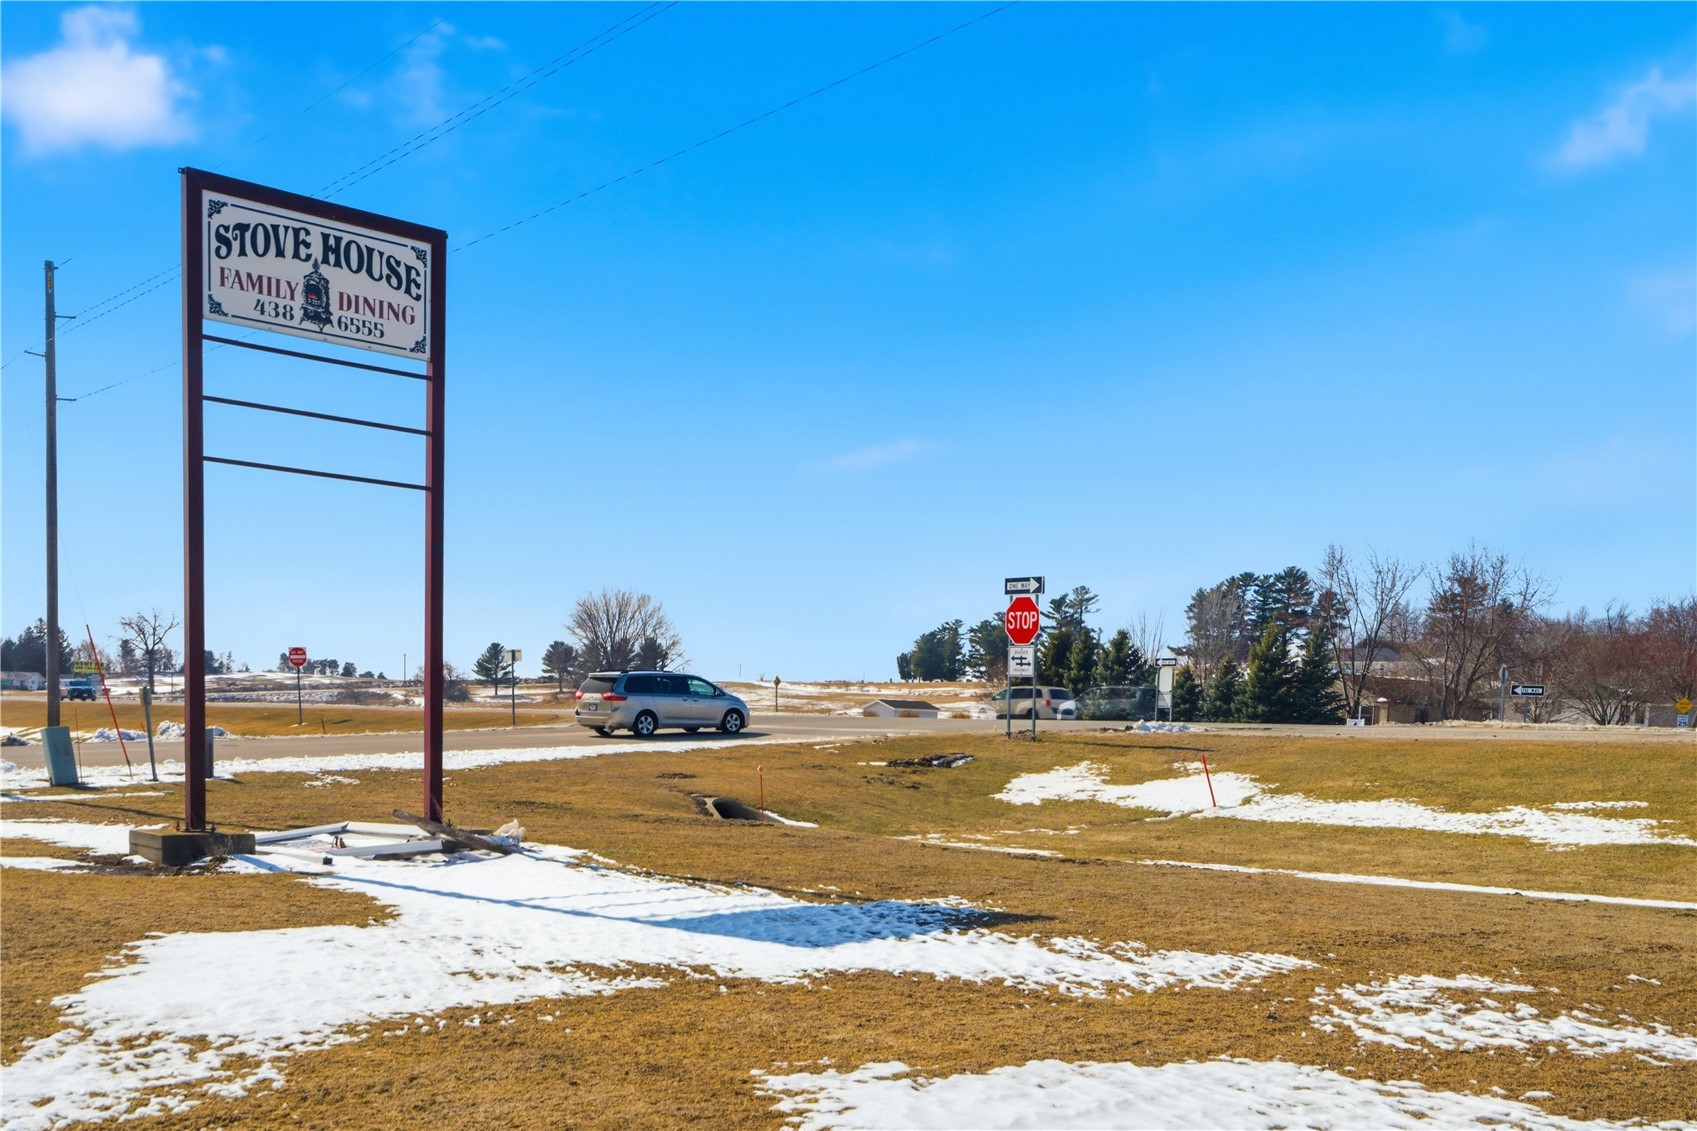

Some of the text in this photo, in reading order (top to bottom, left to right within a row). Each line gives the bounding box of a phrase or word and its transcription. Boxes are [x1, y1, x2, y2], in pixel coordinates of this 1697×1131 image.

[215, 222, 422, 301] STOVE HOUSE
[219, 266, 416, 325] FAMILY DINING
[253, 299, 385, 339] 438 6555
[1008, 611, 1038, 630] STOP
